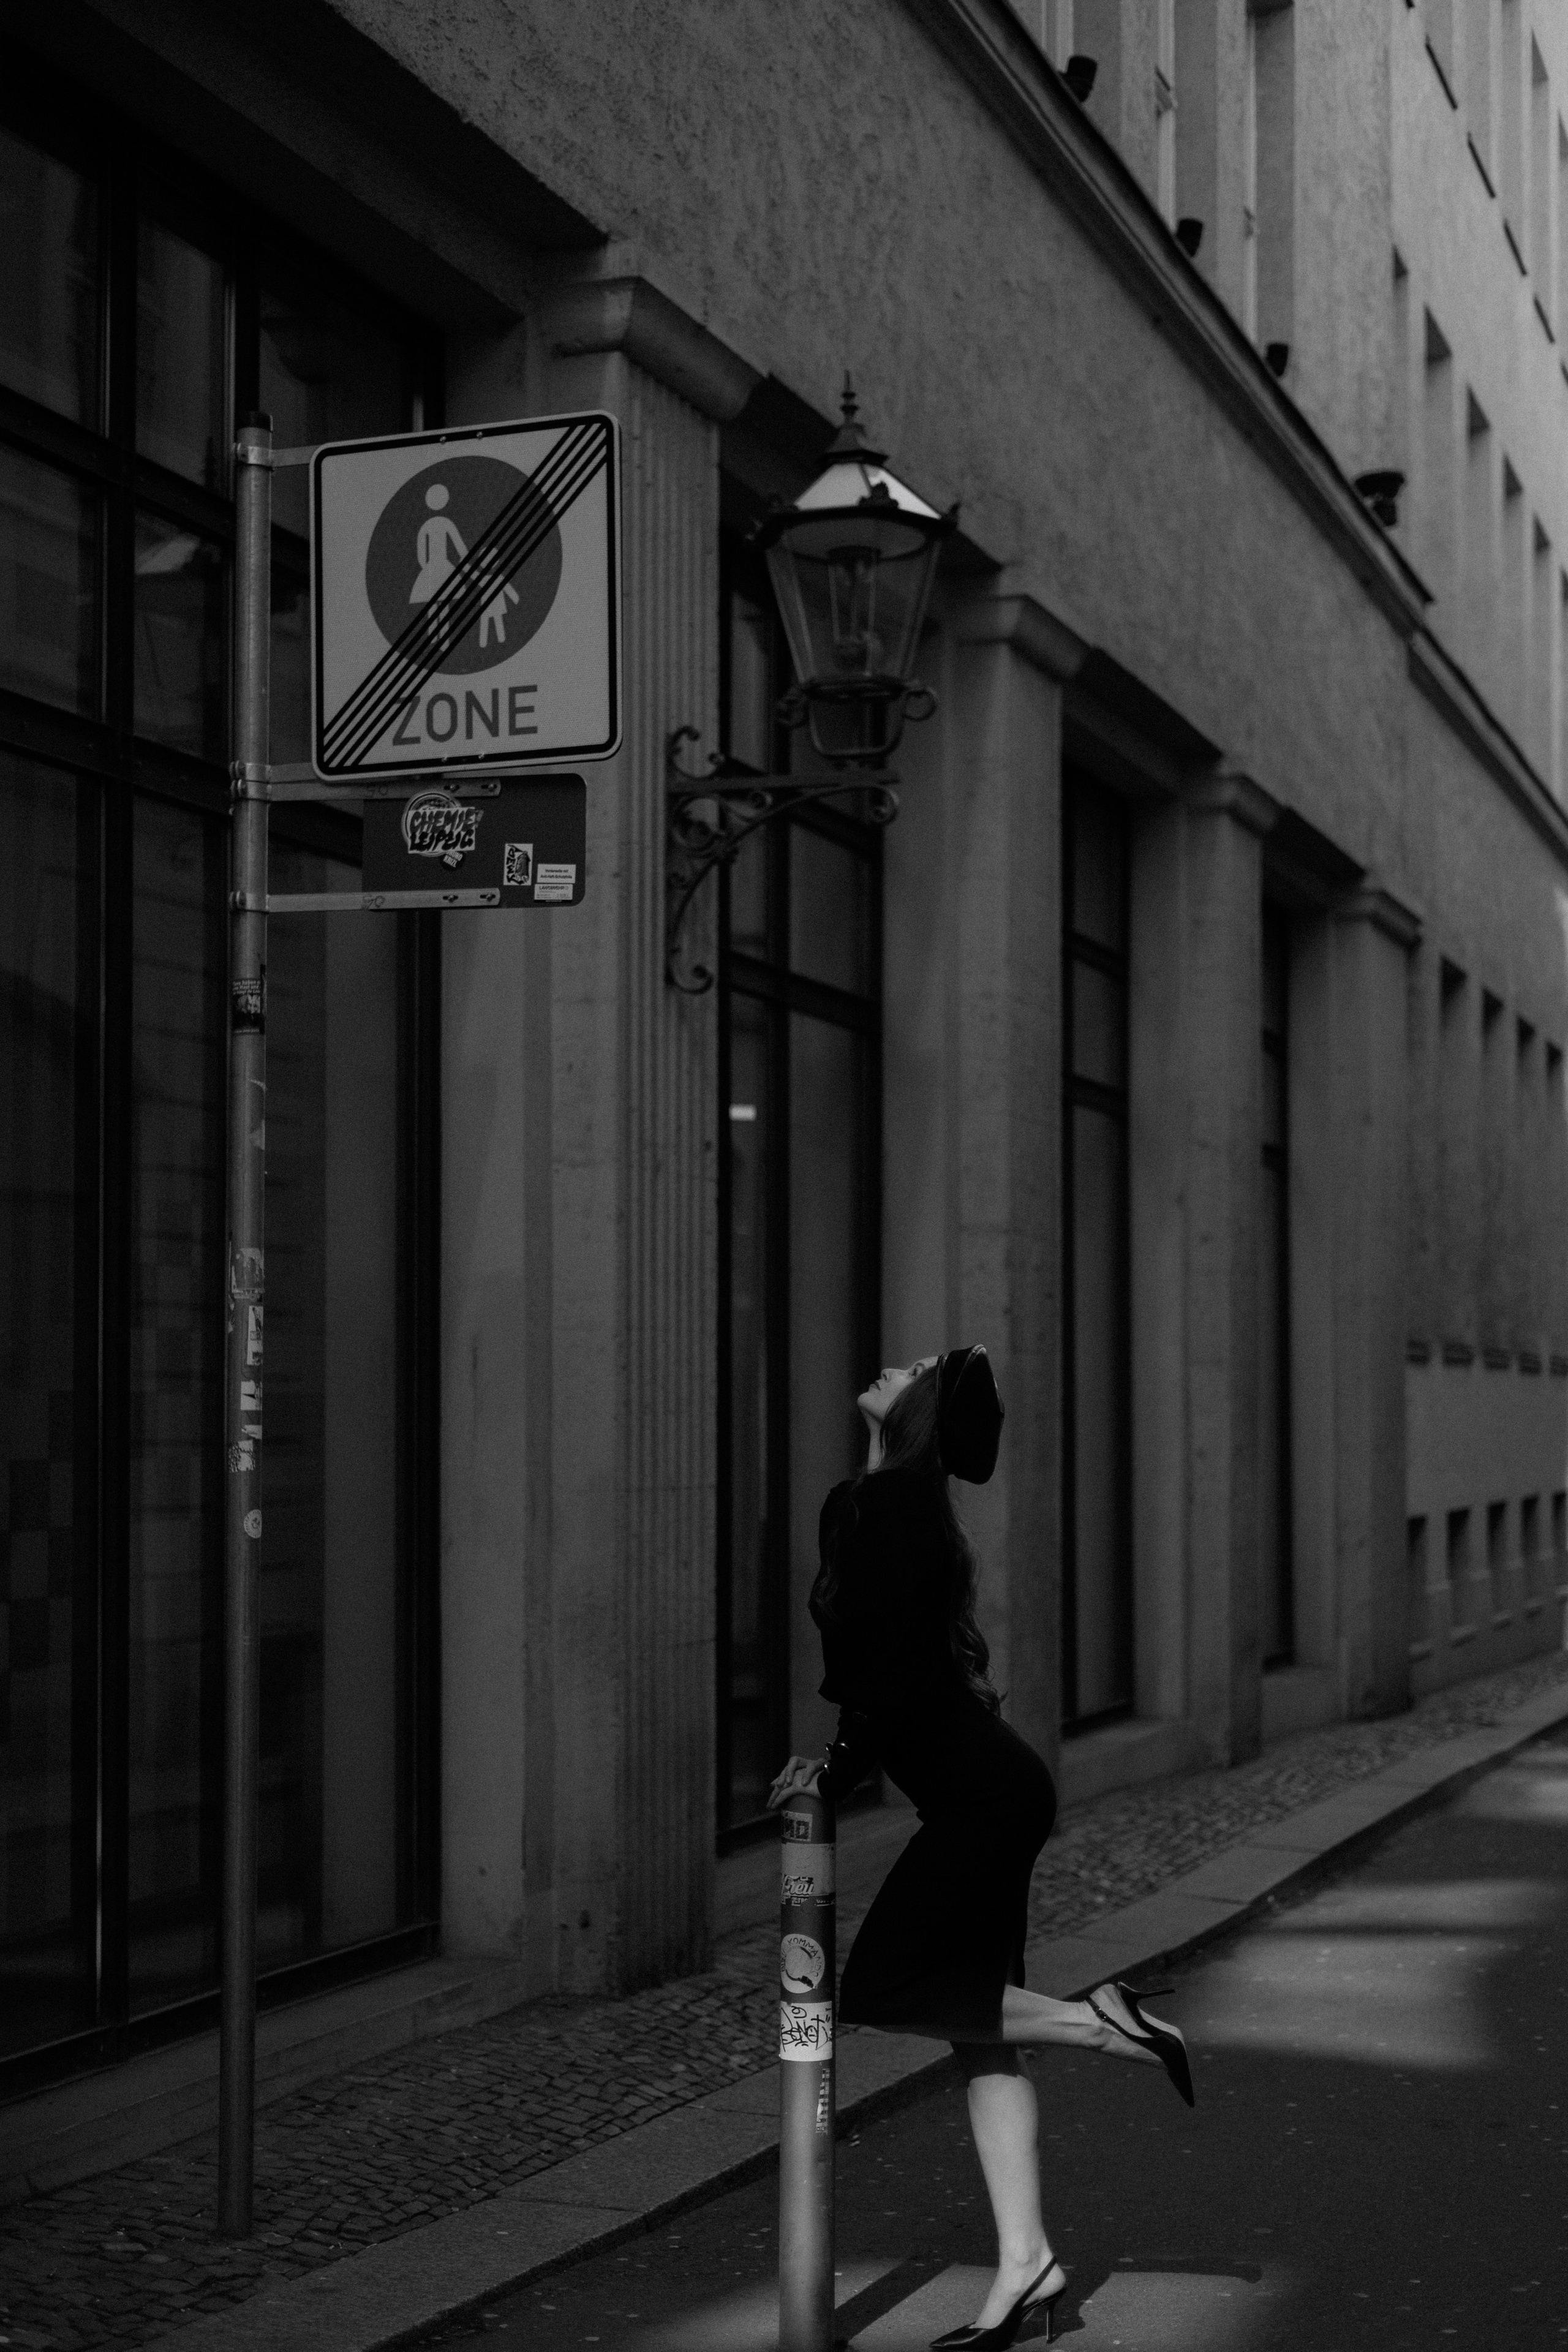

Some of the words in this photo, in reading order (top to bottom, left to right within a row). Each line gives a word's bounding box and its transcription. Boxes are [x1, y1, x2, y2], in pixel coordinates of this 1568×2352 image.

[392, 685, 538, 746] ZONE
[410, 808, 475, 833] CHEMIE
[410, 829, 474, 851] LEIPZIG
